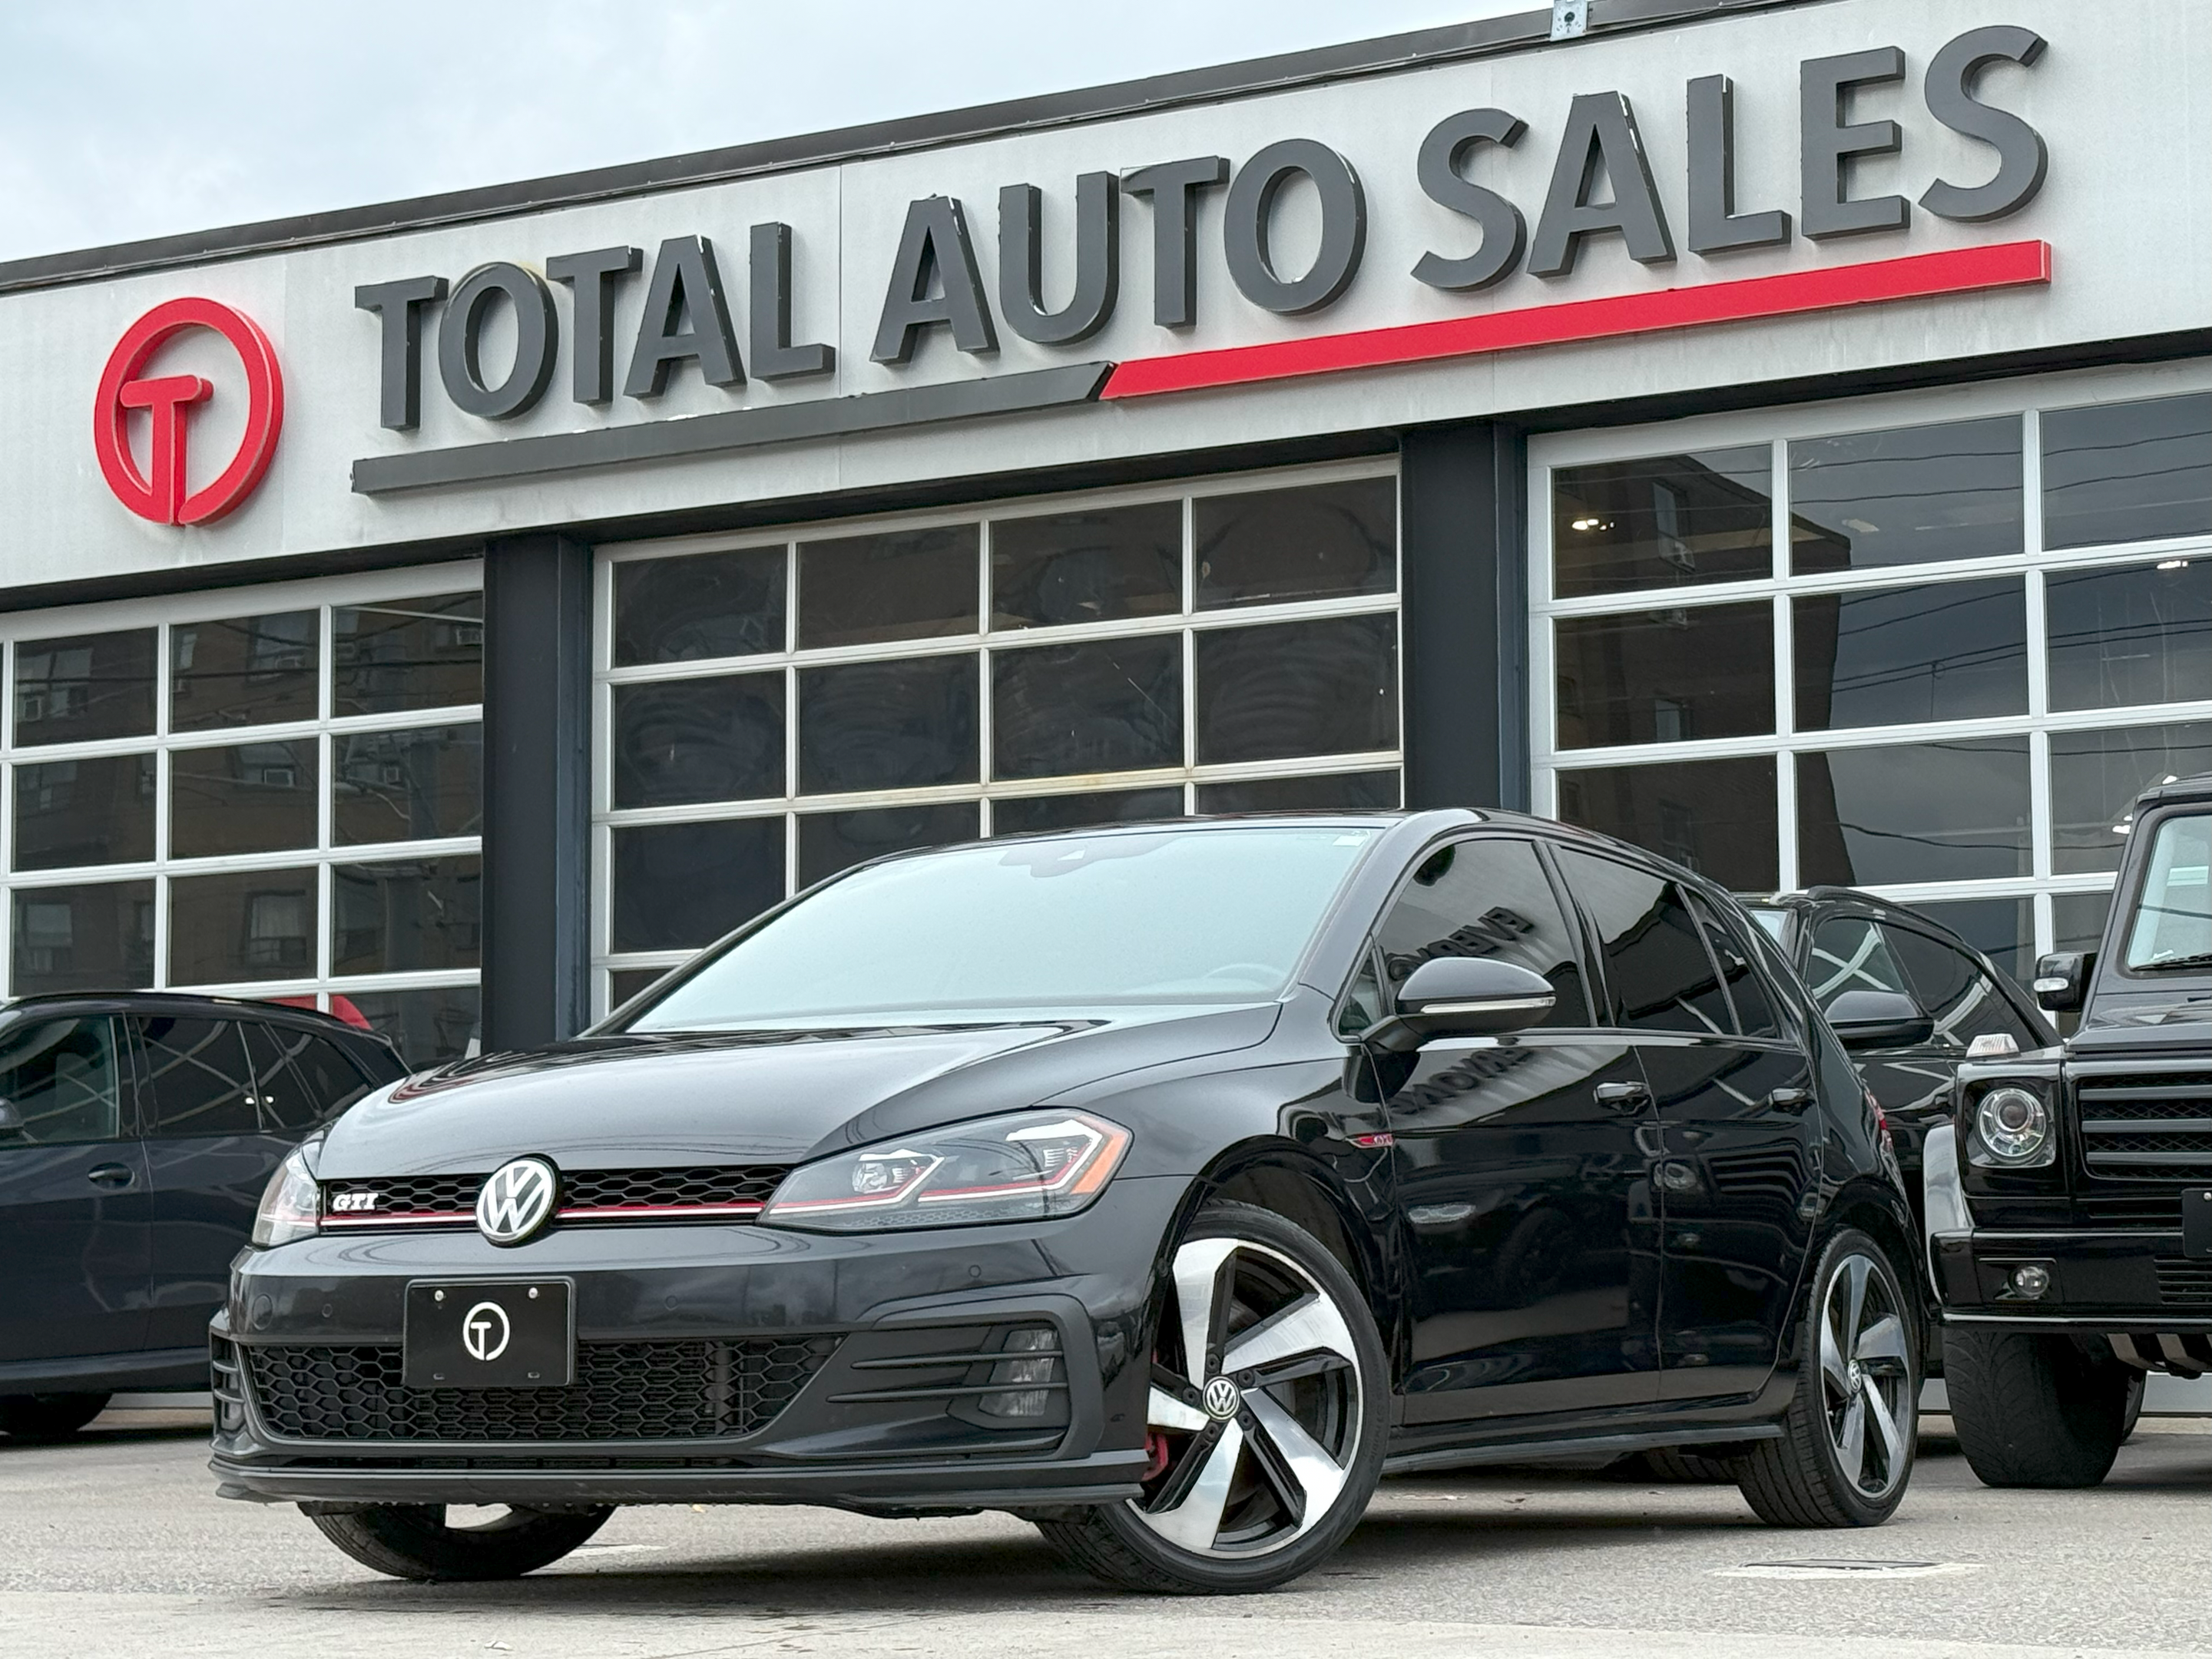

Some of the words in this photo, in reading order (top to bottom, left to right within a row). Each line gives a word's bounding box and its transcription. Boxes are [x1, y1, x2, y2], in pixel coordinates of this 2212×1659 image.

[355, 222, 835, 431] TOTAL
[869, 138, 1367, 364] AUTO
[1410, 25, 2048, 293] SALES
[333, 1193, 379, 1210] GTI
[479, 1163, 550, 1239] VW
[1206, 1379, 1237, 1416] VW
